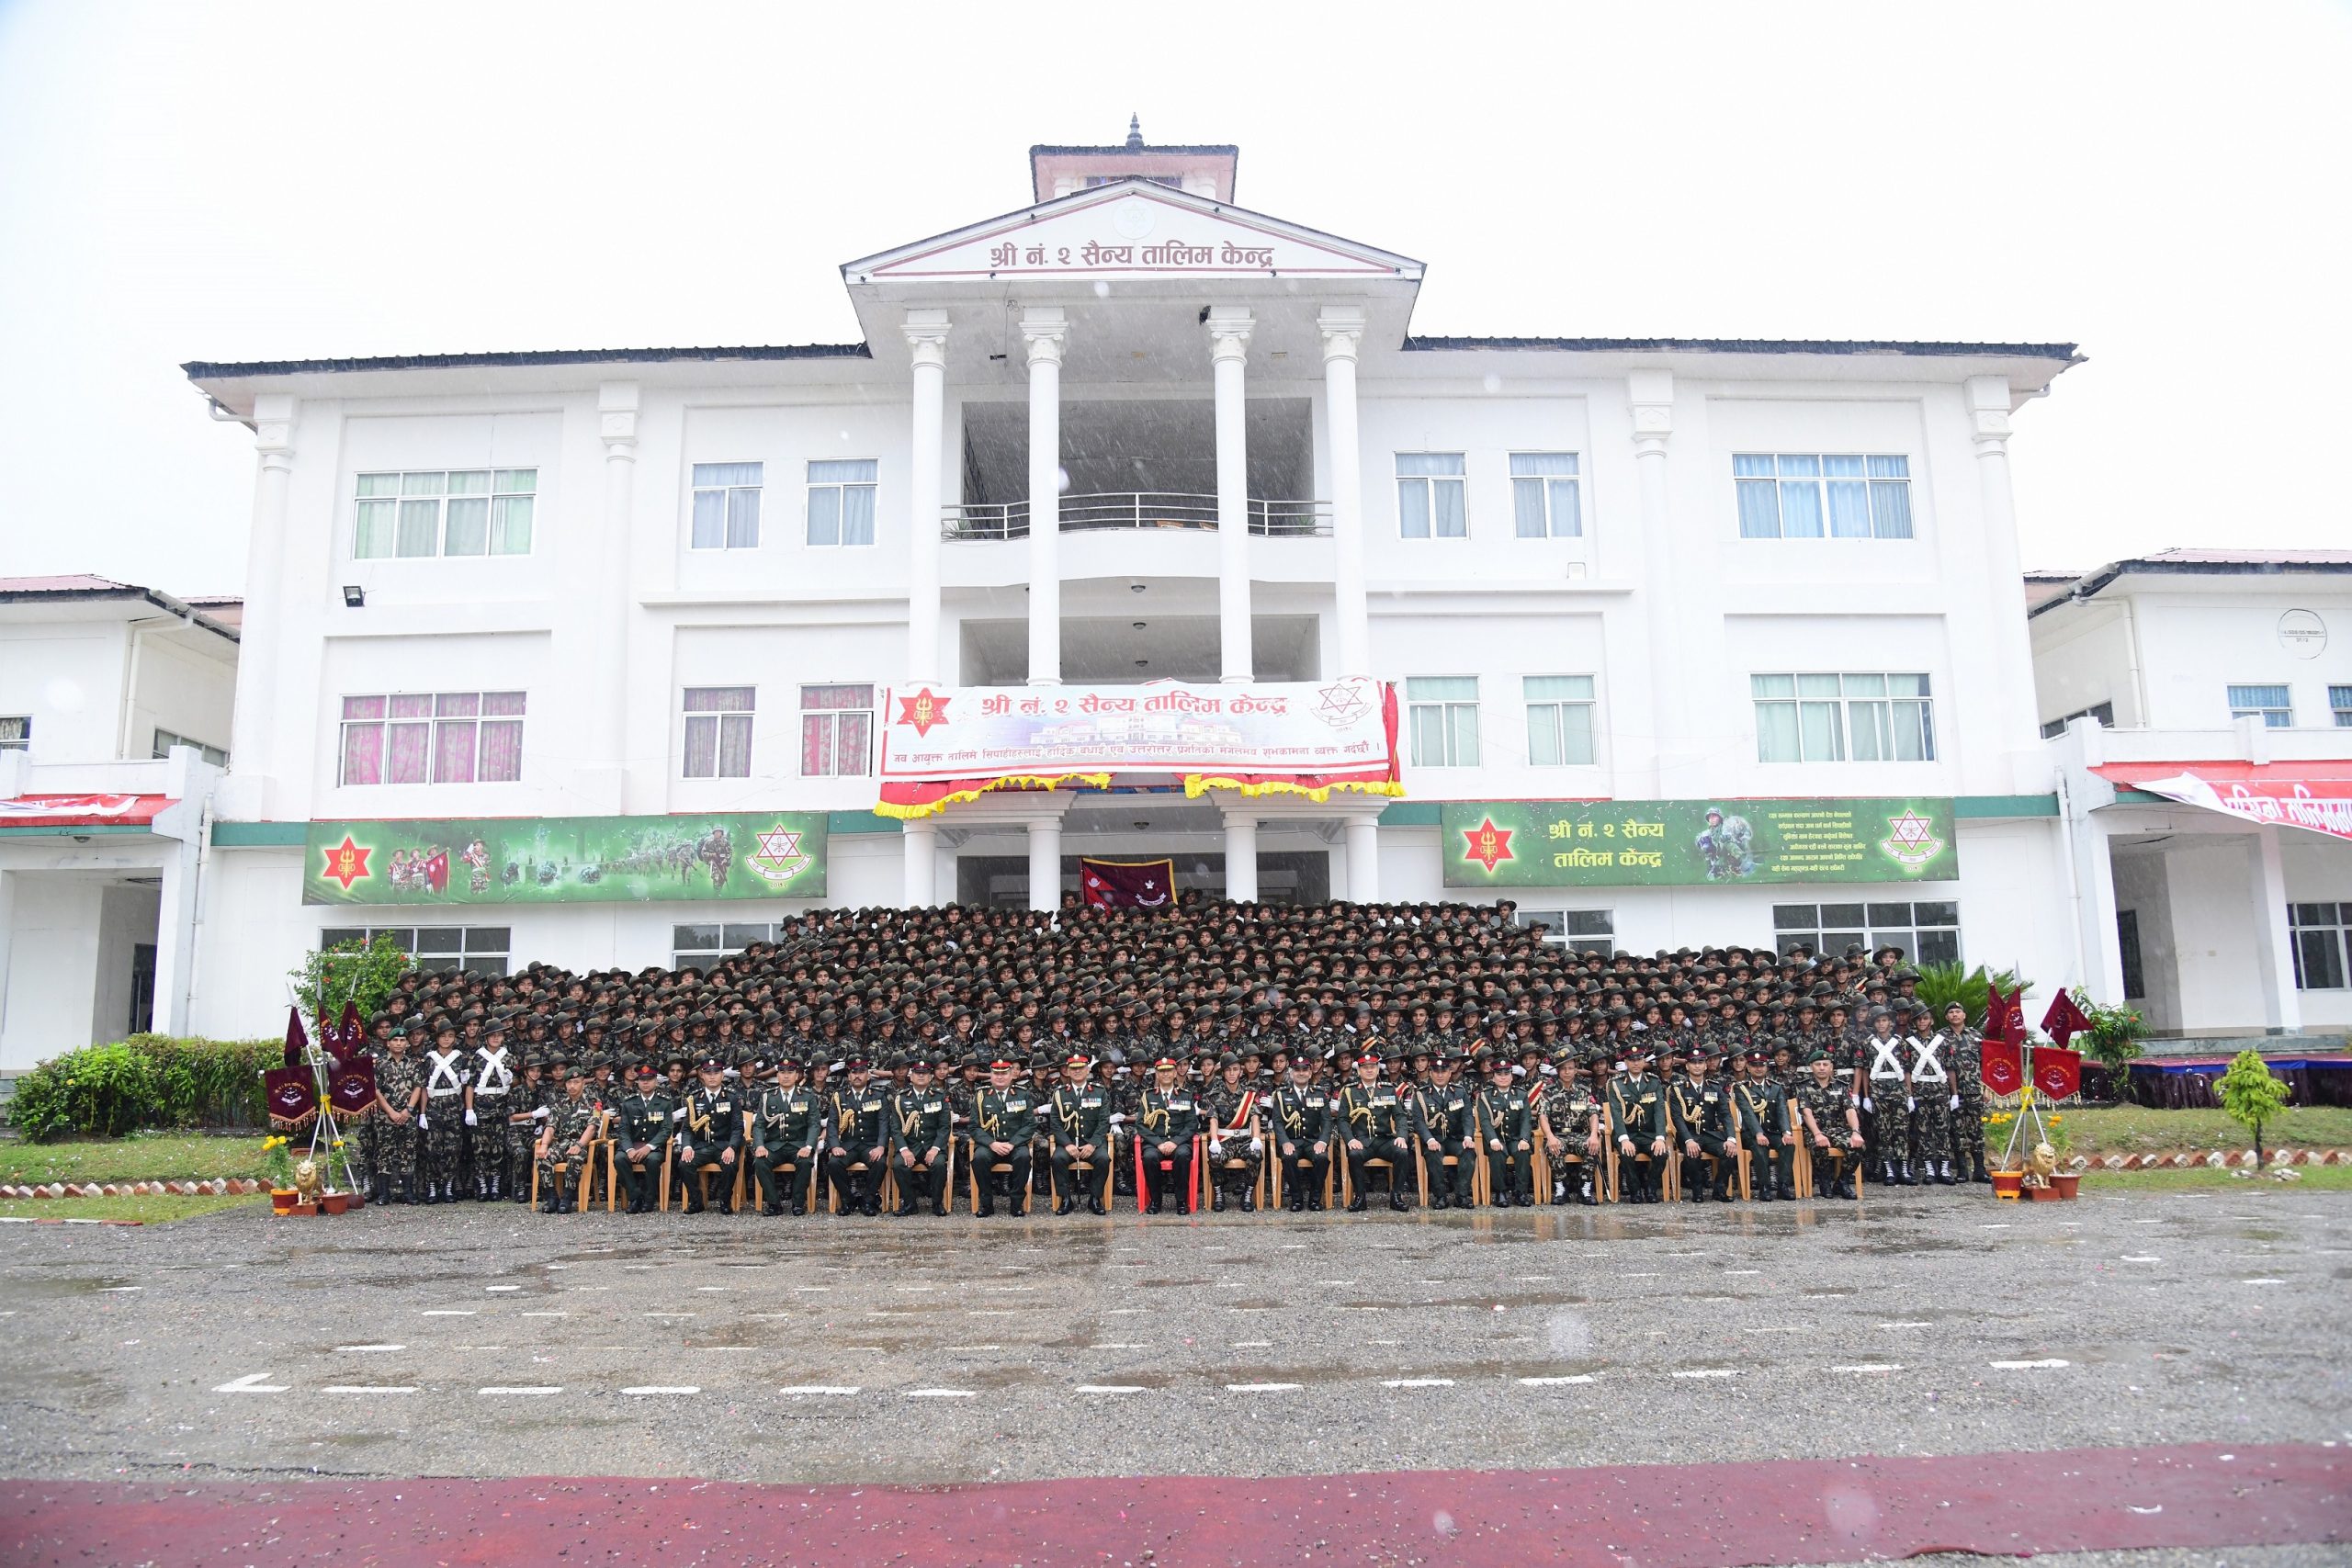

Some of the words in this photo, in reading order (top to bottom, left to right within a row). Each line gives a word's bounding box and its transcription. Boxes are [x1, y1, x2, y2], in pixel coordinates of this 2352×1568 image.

[989, 242, 1019, 267] श्री
[1025, 243, 1048, 265] नं.
[1057, 246, 1071, 265] २
[1080, 239, 1134, 266] सैन्य
[1141, 239, 1215, 265] तालिम
[1221, 241, 1275, 268] केन्द्र
[981, 694, 1012, 716] श्री
[1055, 699, 1069, 714] २
[1078, 693, 1136, 713] सैन्य
[1144, 691, 1221, 714] तालिम
[1229, 694, 1288, 715] केन्द्र
[1548, 818, 1572, 840] श्री
[1603, 824, 1615, 838] २
[1621, 818, 1665, 839] सैन्य
[1553, 847, 1614, 867] तालिम
[1619, 847, 1663, 868] केन्द्र
